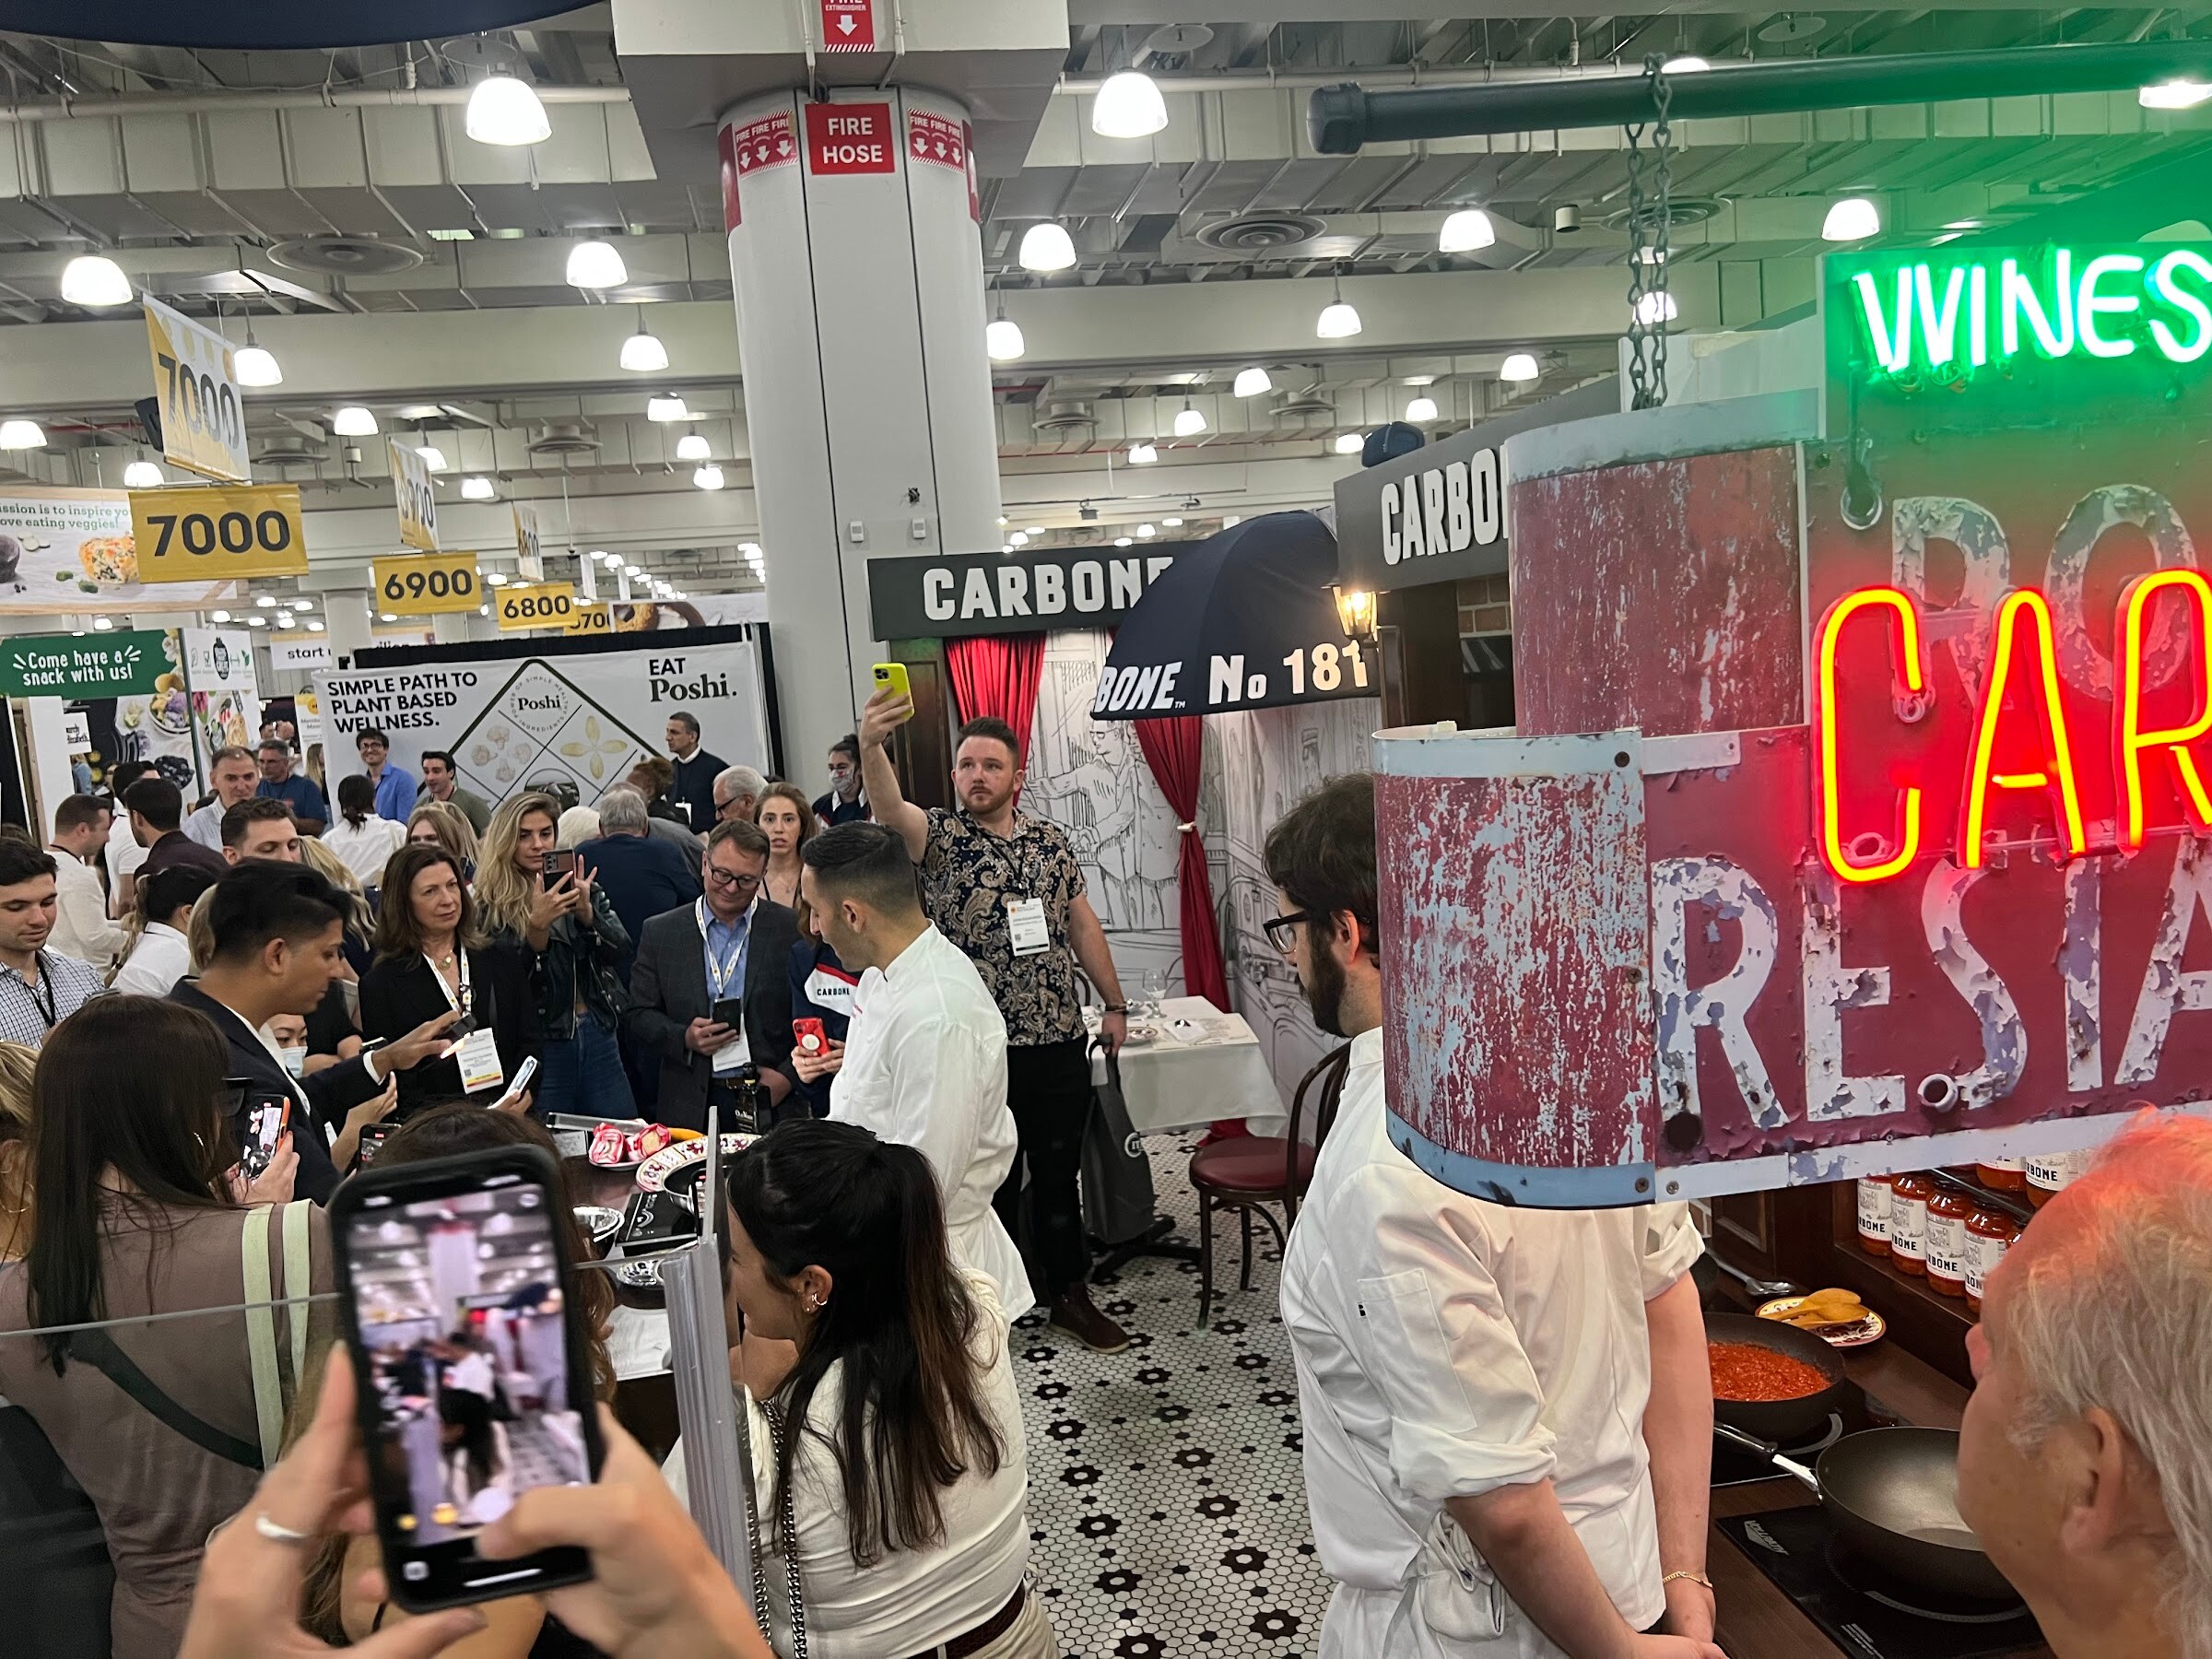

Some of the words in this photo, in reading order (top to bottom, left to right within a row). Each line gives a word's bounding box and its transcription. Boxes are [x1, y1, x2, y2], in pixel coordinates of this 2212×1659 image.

[736, 129, 750, 144] FIRE
[751, 123, 770, 136] FIRE
[828, 117, 874, 135] FIRE
[910, 116, 929, 128] FIRE
[930, 120, 947, 133] FIRE
[822, 145, 884, 164] HOSE
[1852, 248, 2212, 373] WINES
[158, 352, 240, 450] 7000
[40, 503, 50, 513] is
[53, 505, 65, 514] to
[69, 504, 112, 518] inspire
[25, 516, 65, 530] eating
[147, 510, 291, 558] 7000
[384, 569, 473, 600] 6900
[503, 595, 571, 619] 6800
[570, 612, 611, 629] 70
[28, 652, 69, 670] Come
[74, 649, 109, 666] have
[114, 649, 123, 664] a
[288, 648, 324, 659] start
[22, 668, 65, 687] snack
[70, 665, 104, 683] with
[110, 663, 133, 680] us!
[649, 657, 686, 676] EAT
[1208, 654, 1268, 705] No
[1282, 639, 1369, 695] 181
[327, 677, 395, 696] SIMPLE
[399, 673, 448, 691] PATH
[451, 672, 477, 688] TO
[649, 673, 737, 702] Poshi.
[331, 696, 391, 715] PLANT
[397, 691, 457, 711] BASED
[518, 694, 560, 711] Poshi
[334, 712, 440, 734] WELLNESS.
[1813, 567, 2212, 883] CAR
